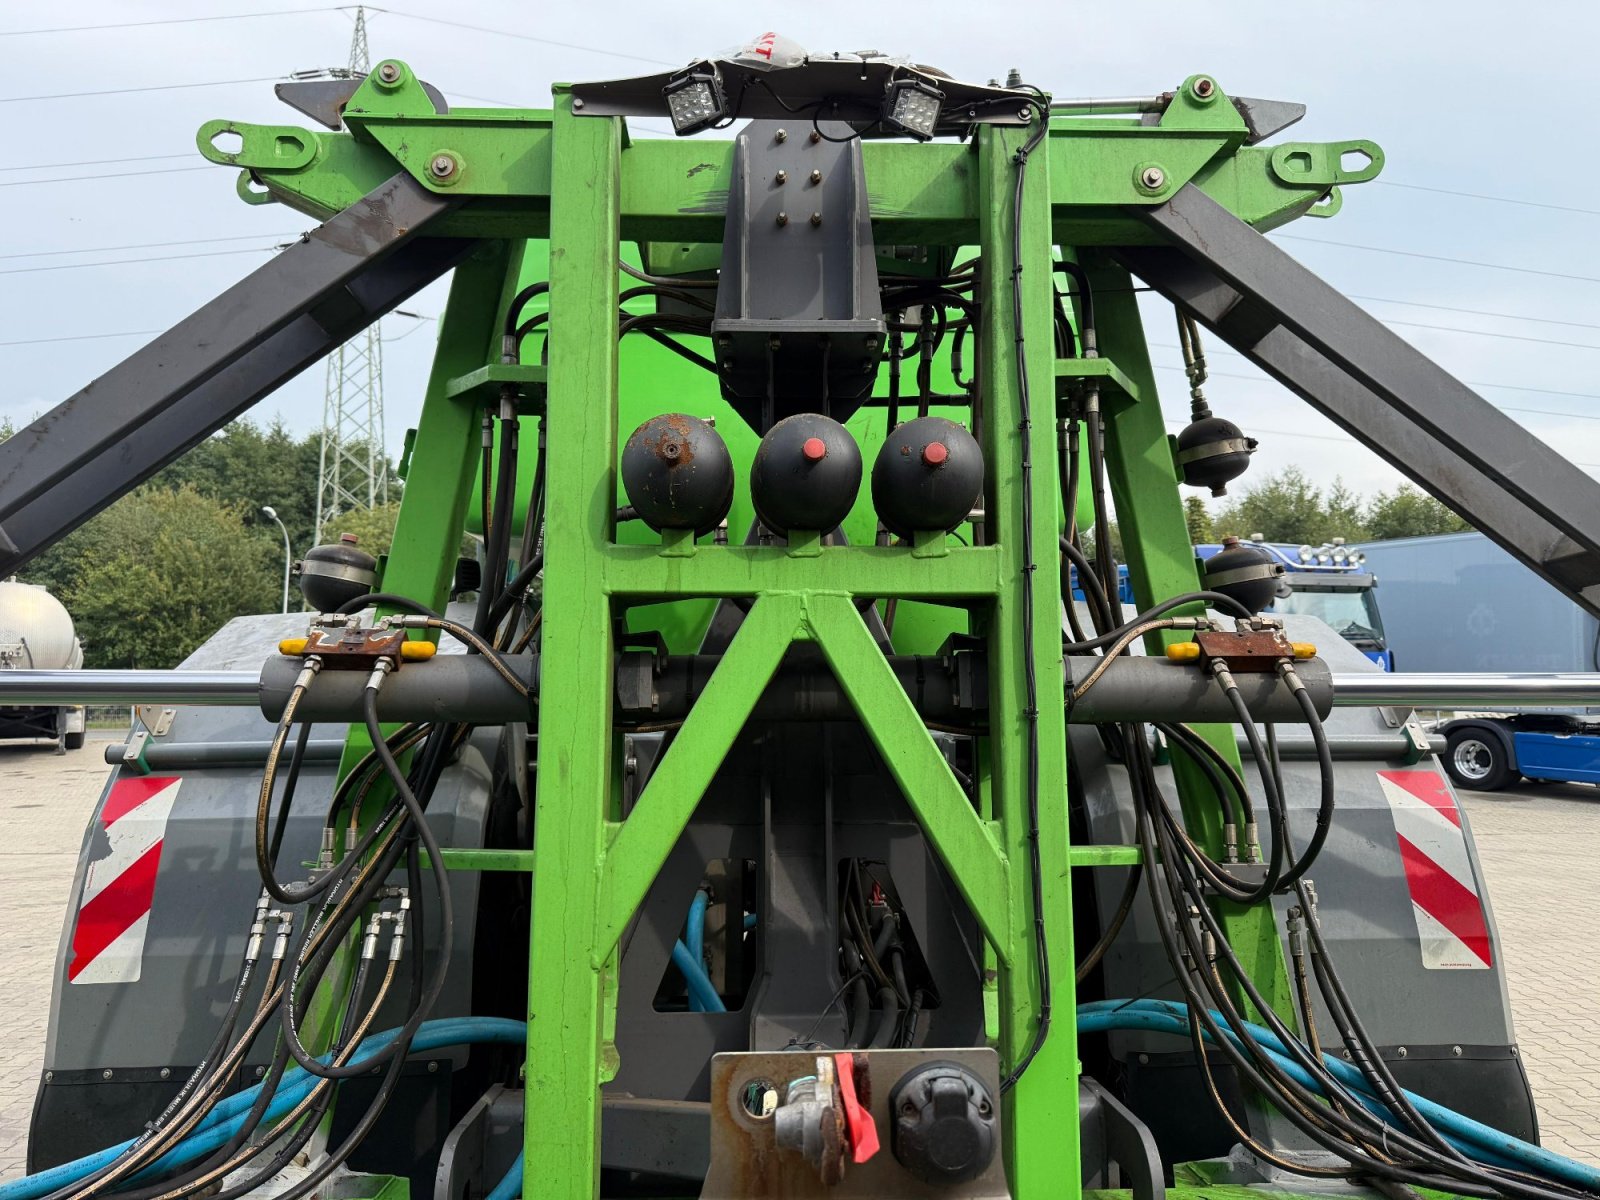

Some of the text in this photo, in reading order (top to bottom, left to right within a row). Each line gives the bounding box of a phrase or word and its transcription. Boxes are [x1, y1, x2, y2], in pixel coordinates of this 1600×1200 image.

[322, 878, 343, 910] HYDRAULIK
[179, 1060, 207, 1098] HYDRAULIK
[154, 1097, 181, 1127] MUELLER
[133, 1128, 153, 1148] HEINE
